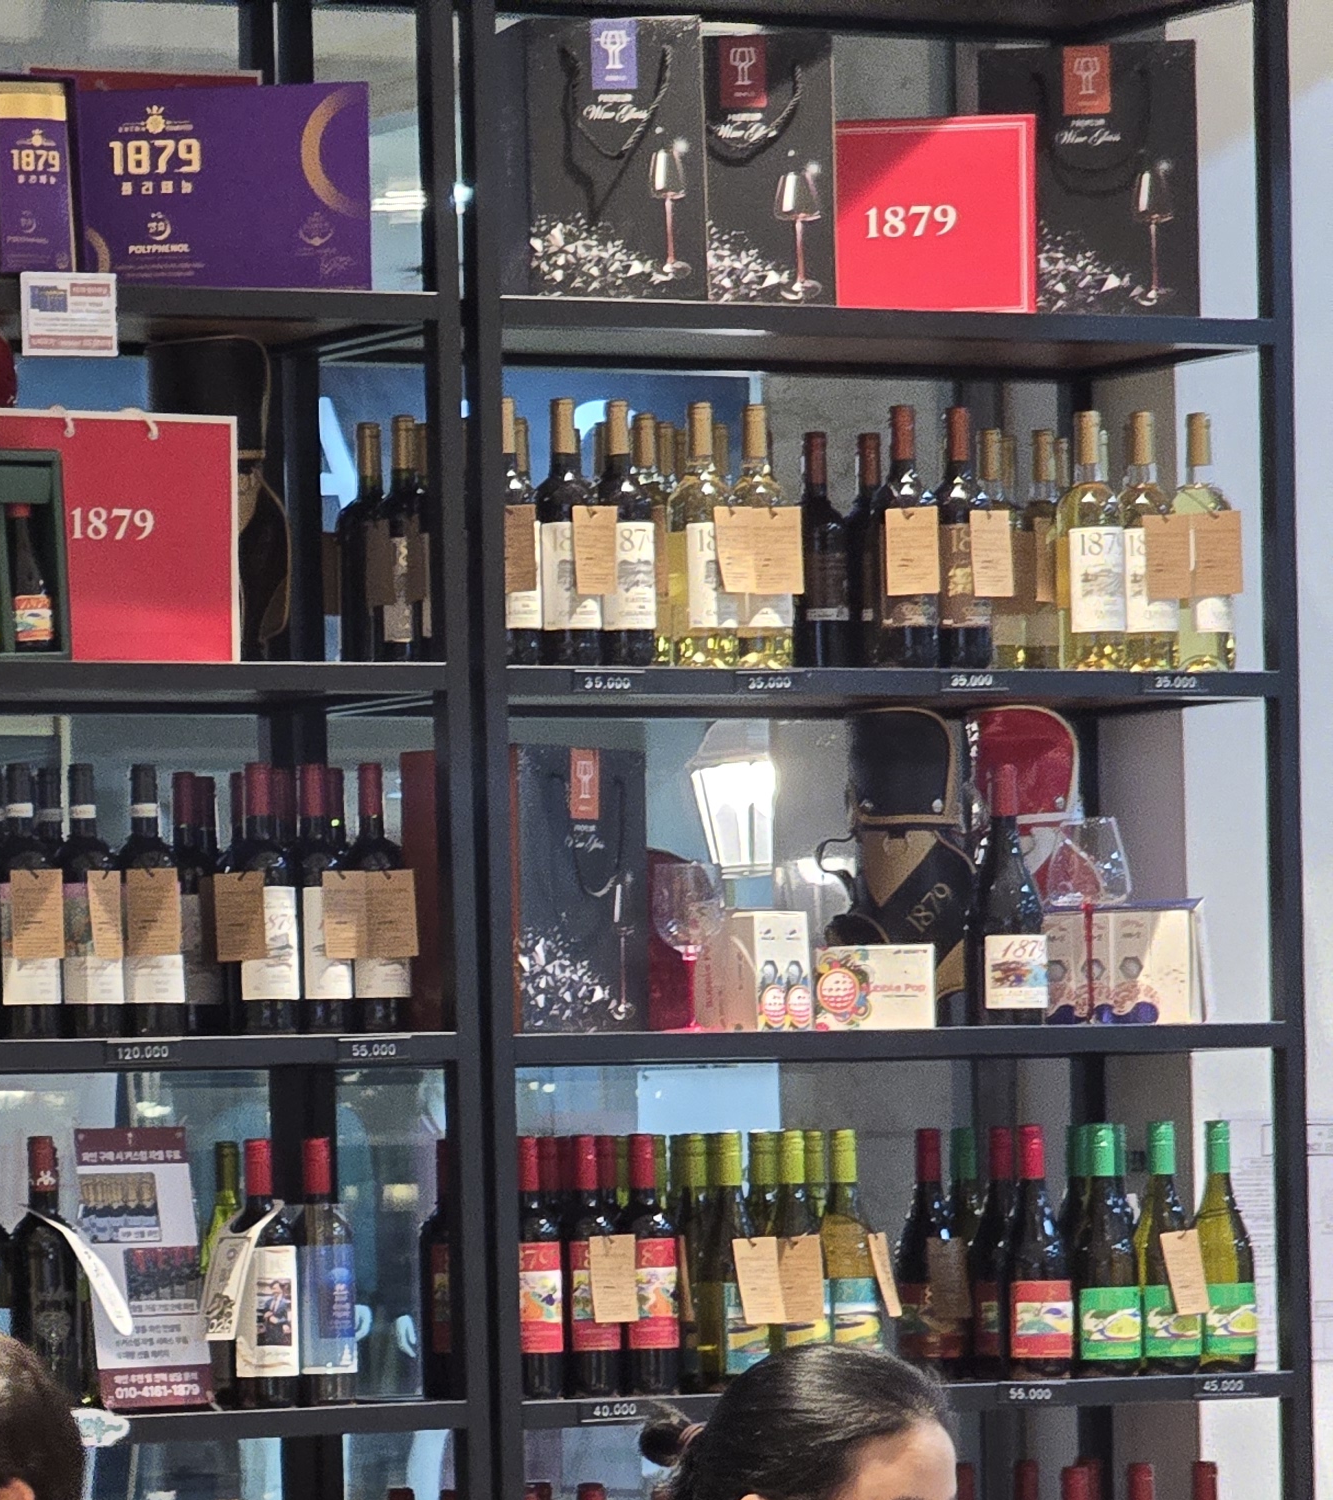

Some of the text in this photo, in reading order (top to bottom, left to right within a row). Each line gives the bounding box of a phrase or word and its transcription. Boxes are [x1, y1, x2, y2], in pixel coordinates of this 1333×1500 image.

[10, 148, 61, 173] 1879
[109, 138, 202, 176] 1879
[863, 204, 958, 241] 1879
[128, 242, 191, 255] POLYPHENOL
[70, 507, 156, 542] 1879
[905, 882, 952, 933] 1879
